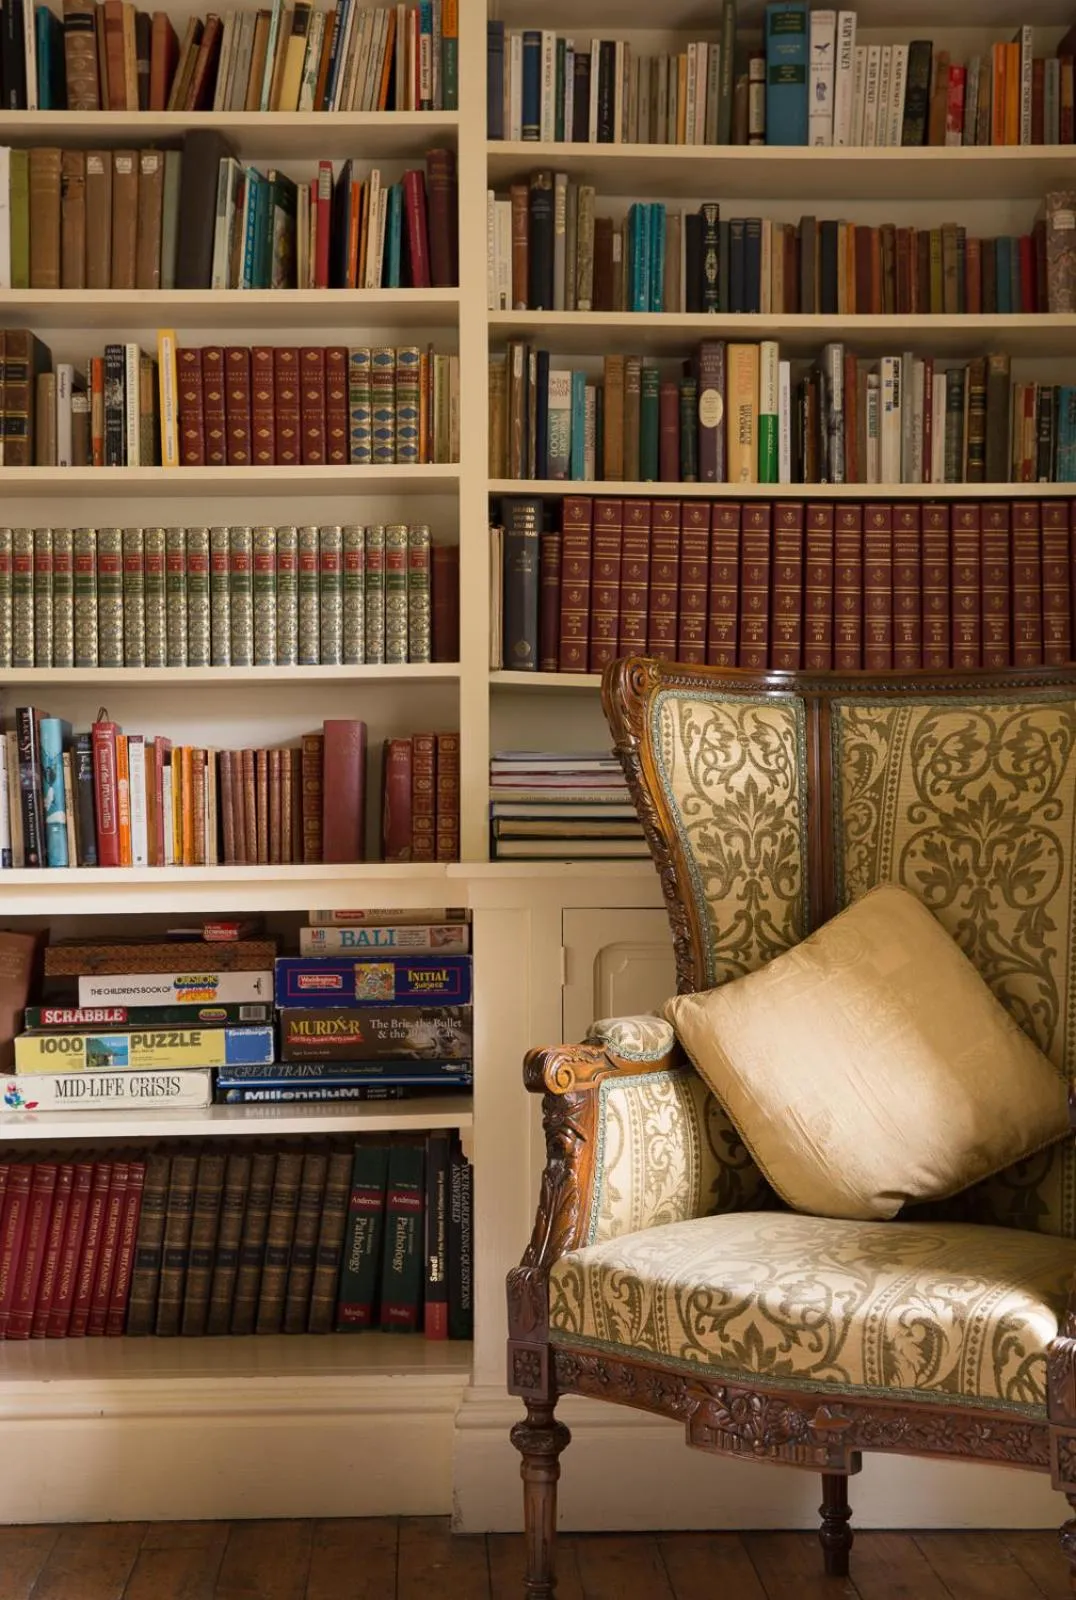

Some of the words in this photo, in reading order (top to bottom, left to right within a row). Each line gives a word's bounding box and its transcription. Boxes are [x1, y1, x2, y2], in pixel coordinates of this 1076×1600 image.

[550, 414, 559, 458] ATWOOD
[340, 929, 396, 947] BALI
[408, 969, 449, 982] INITIAL
[104, 987, 142, 995] CHILDREN'S
[44, 1008, 124, 1023] SCRABBLE
[370, 1019, 390, 1028] The
[434, 1018, 462, 1028] Bullet
[130, 1032, 201, 1049] PUZZLE
[378, 1030, 386, 1039] &
[390, 1029, 406, 1039] the
[40, 1038, 83, 1053] 1000
[234, 1065, 276, 1077] GREAT
[278, 1064, 324, 1076] TRAINS
[55, 1078, 124, 1098] MID-LIFE
[130, 1076, 181, 1098] CRISIS
[462, 1163, 470, 1190] YOUR
[452, 1164, 461, 1223] ANSWERED
[461, 1192, 470, 1253] GARDENING
[349, 1217, 367, 1274] Pathology
[392, 1216, 408, 1273] Pathology
[430, 1256, 438, 1282] Saved!
[460, 1254, 470, 1310] QUESTIONS
